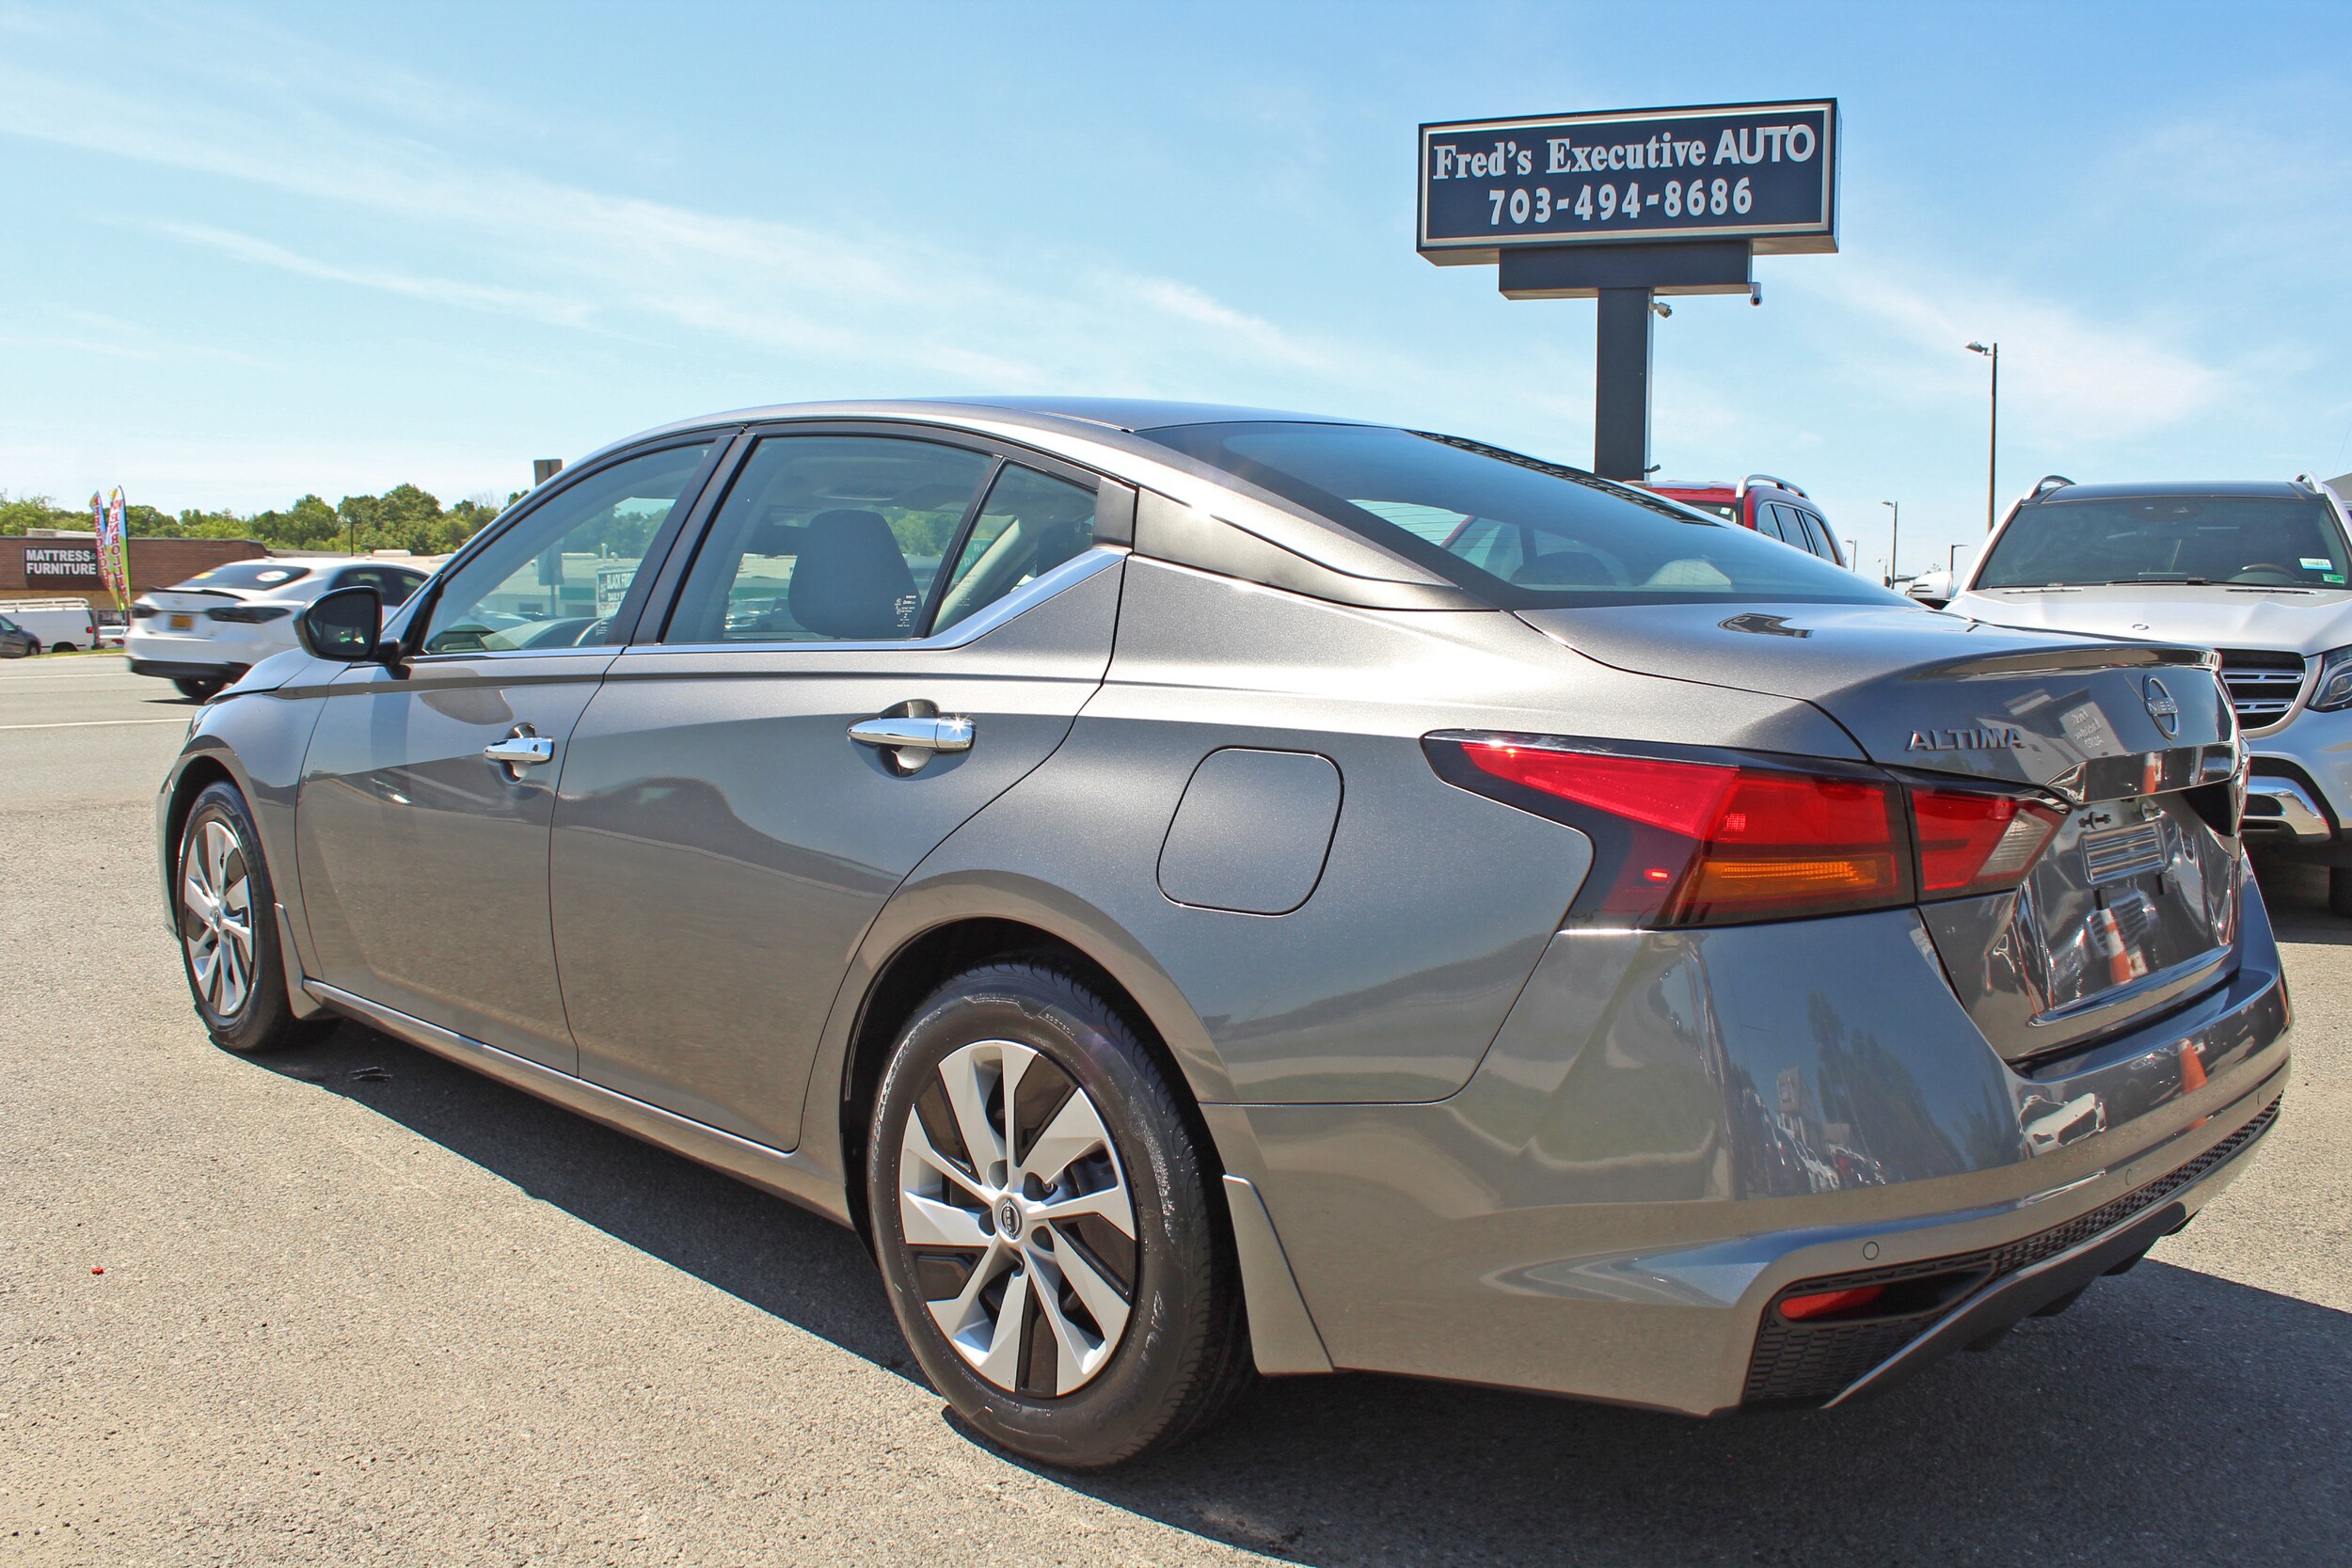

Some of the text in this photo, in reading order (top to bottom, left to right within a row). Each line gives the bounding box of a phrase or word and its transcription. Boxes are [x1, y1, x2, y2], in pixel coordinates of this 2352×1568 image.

[1433, 123, 1816, 181] Fred's Executive AUTO
[1488, 176, 1754, 226] 703-494-8686
[25, 549, 91, 562] MATTRESS
[25, 562, 97, 575] FURNITURE
[2147, 701, 2175, 712] NISS
[1904, 727, 2027, 752] ALTIMA
